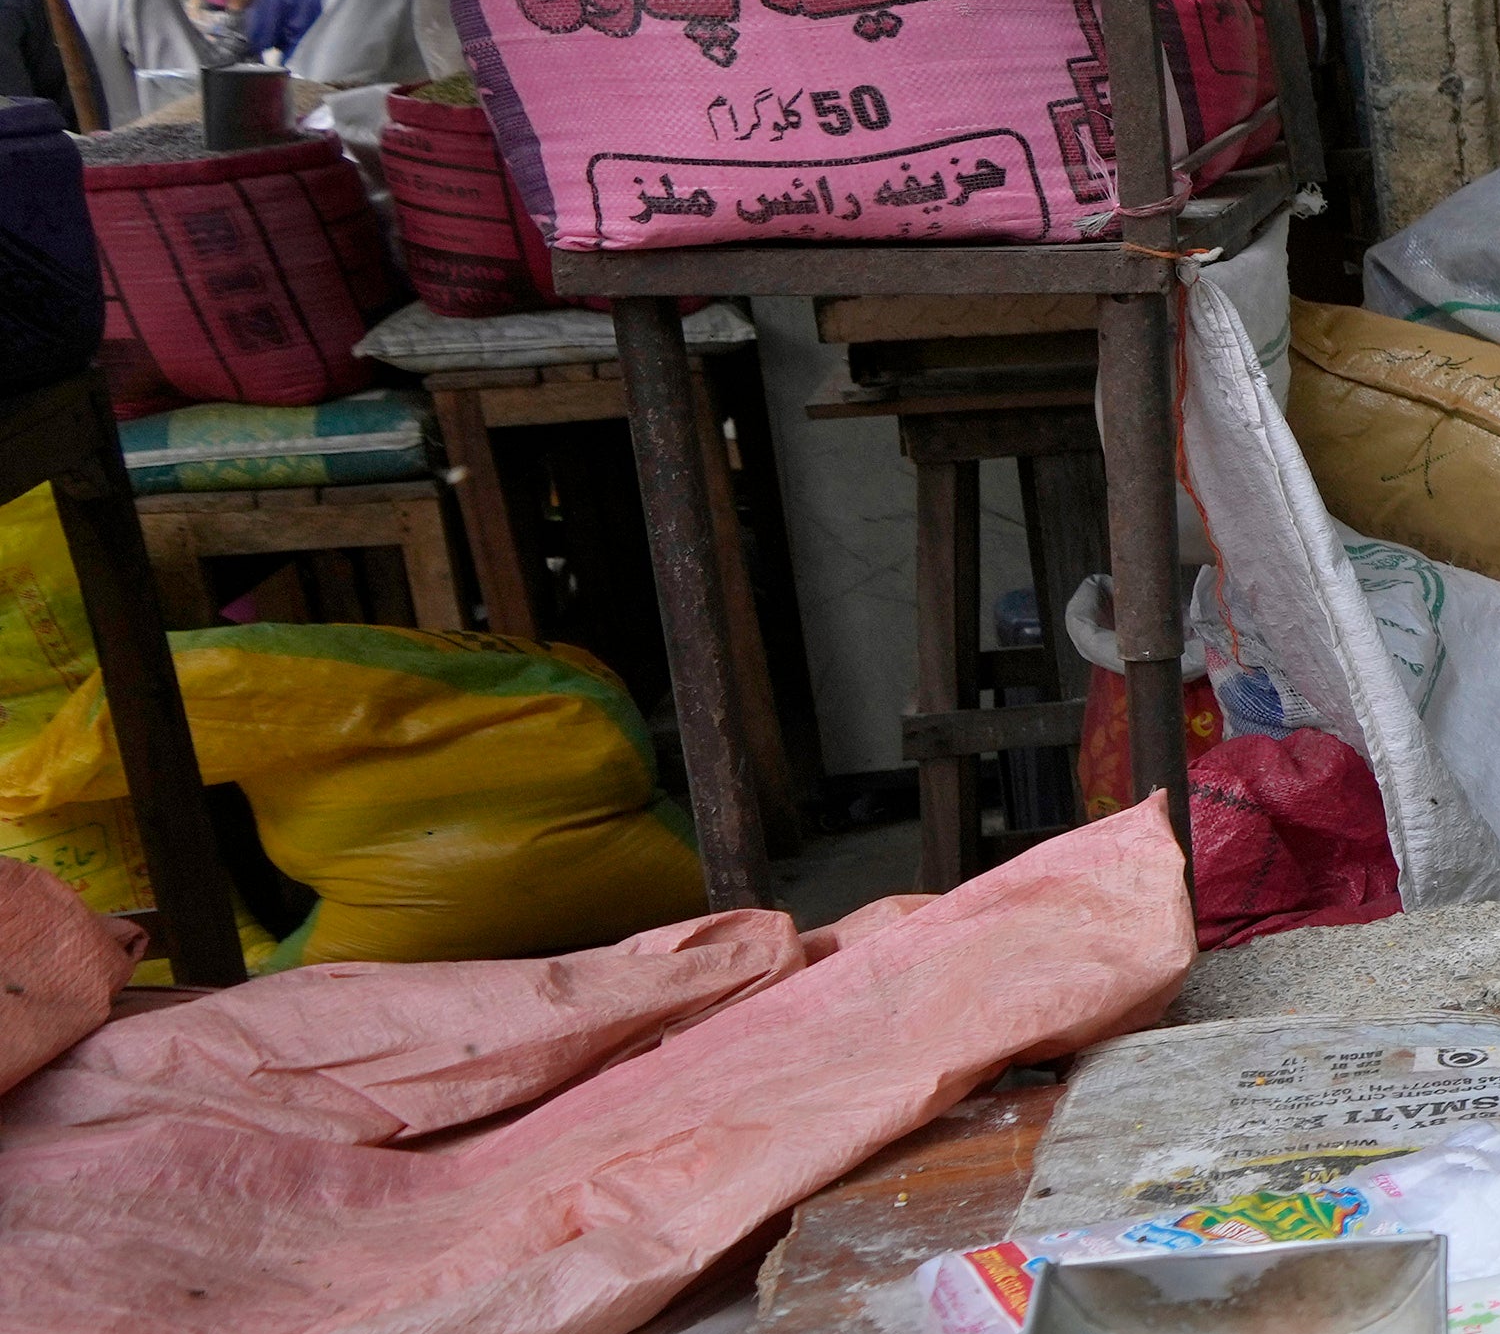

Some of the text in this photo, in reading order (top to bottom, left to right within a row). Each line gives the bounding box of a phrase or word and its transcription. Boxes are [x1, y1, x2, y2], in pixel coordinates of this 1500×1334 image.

[810, 85, 892, 137] 50
[629, 173, 719, 224] ملز
[736, 175, 864, 224] رائس
[1369, 1083, 1396, 1093] PH
[1392, 1087, 1487, 1100] OPPOSITE
[1343, 1092, 1388, 1104] CITY
[1408, 1117, 1447, 1131] BY
